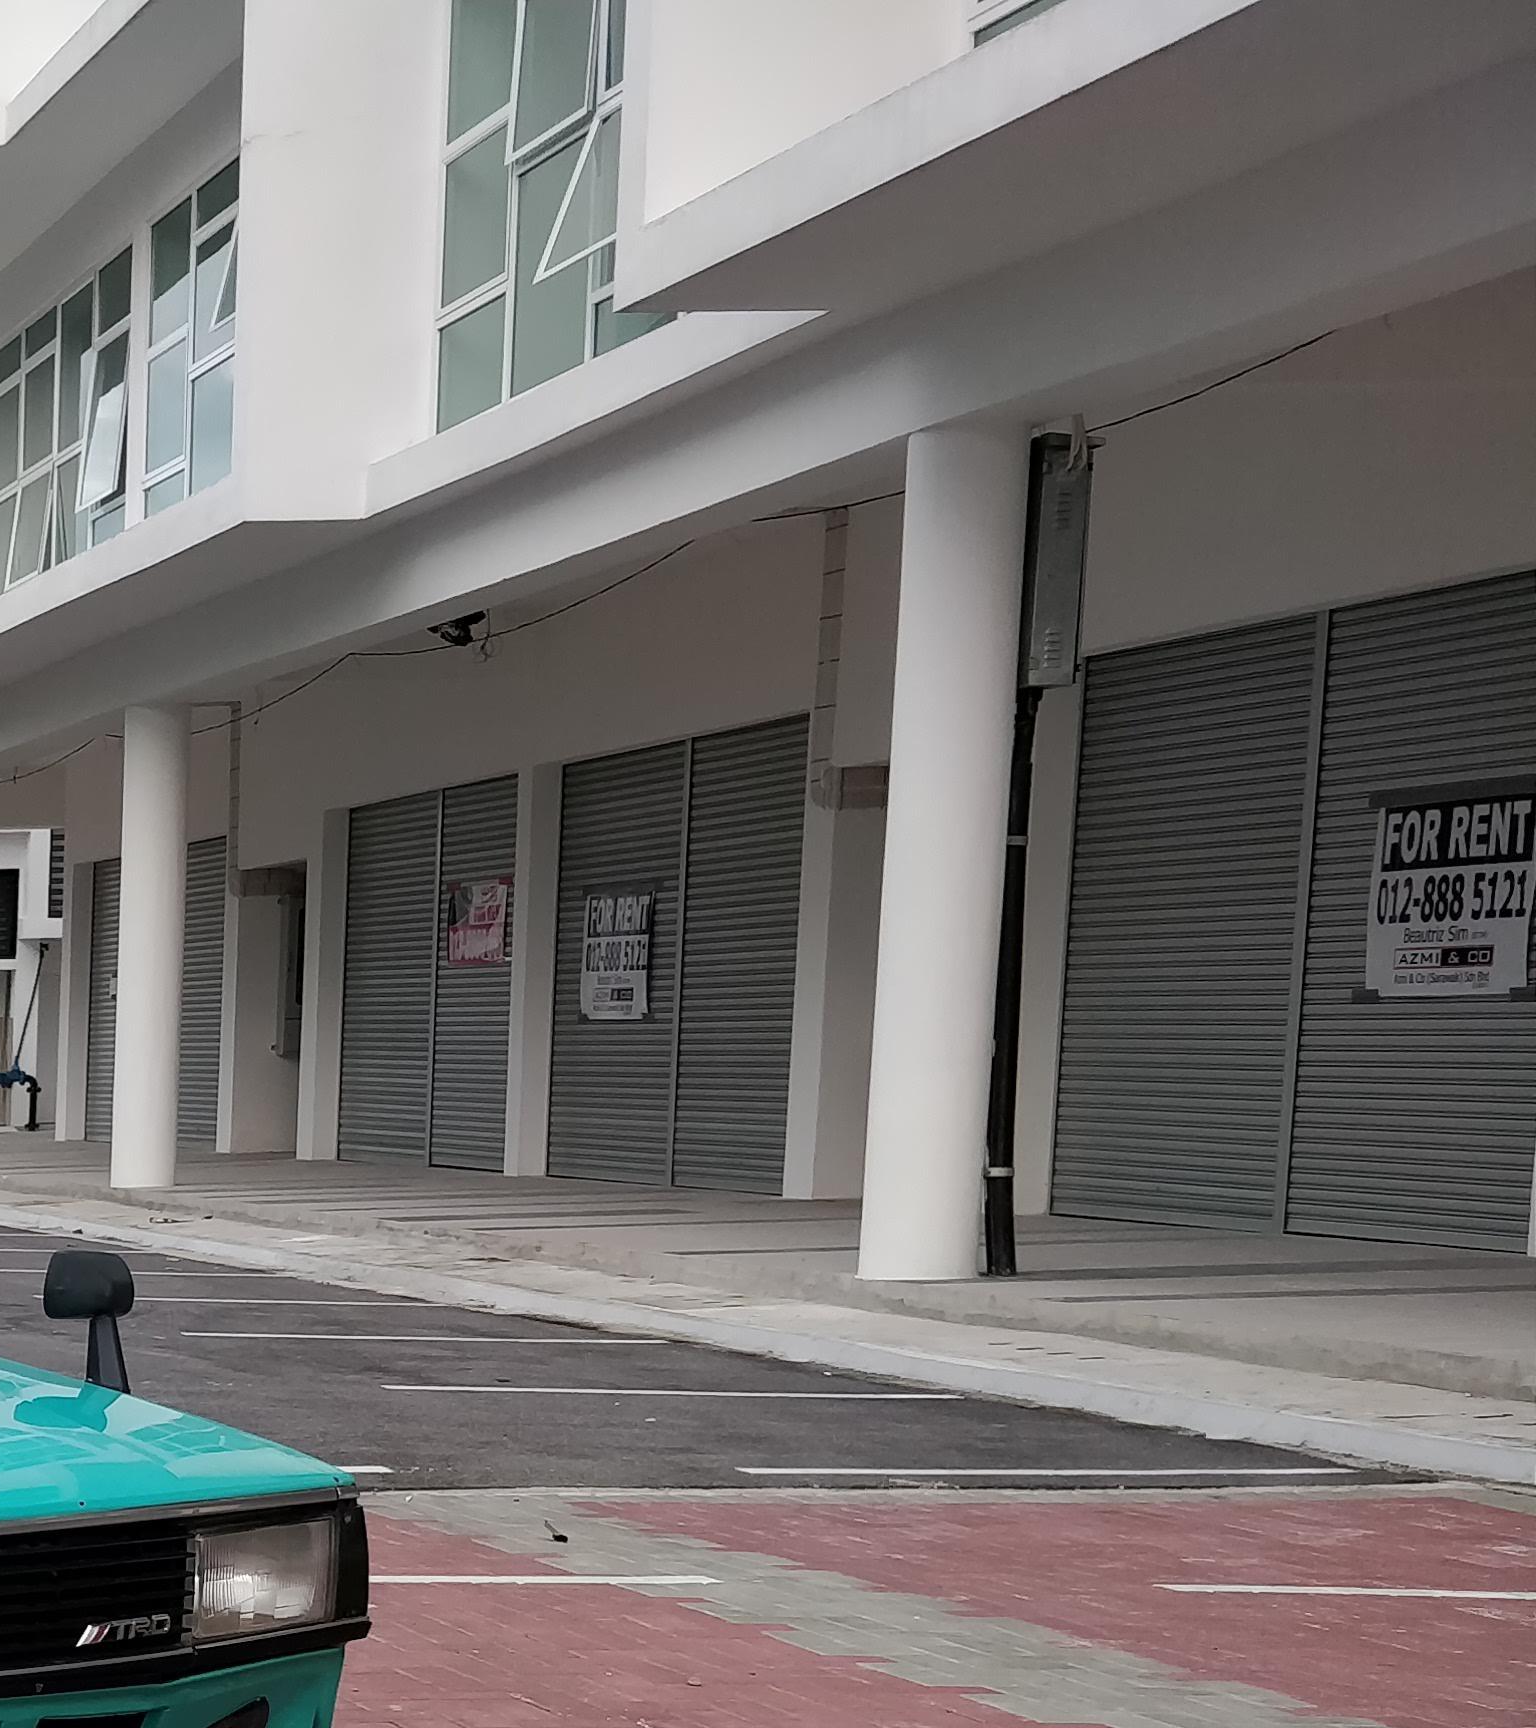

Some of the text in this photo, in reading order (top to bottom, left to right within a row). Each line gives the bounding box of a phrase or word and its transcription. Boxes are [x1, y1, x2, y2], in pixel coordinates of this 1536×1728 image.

[1383, 800, 1532, 865] FOR RENT
[589, 896, 650, 935] FOR RENT
[1377, 870, 1528, 925] 012-888 5121
[1398, 950, 1491, 965] AZMI & CO
[111, 1613, 171, 1640] TRD
